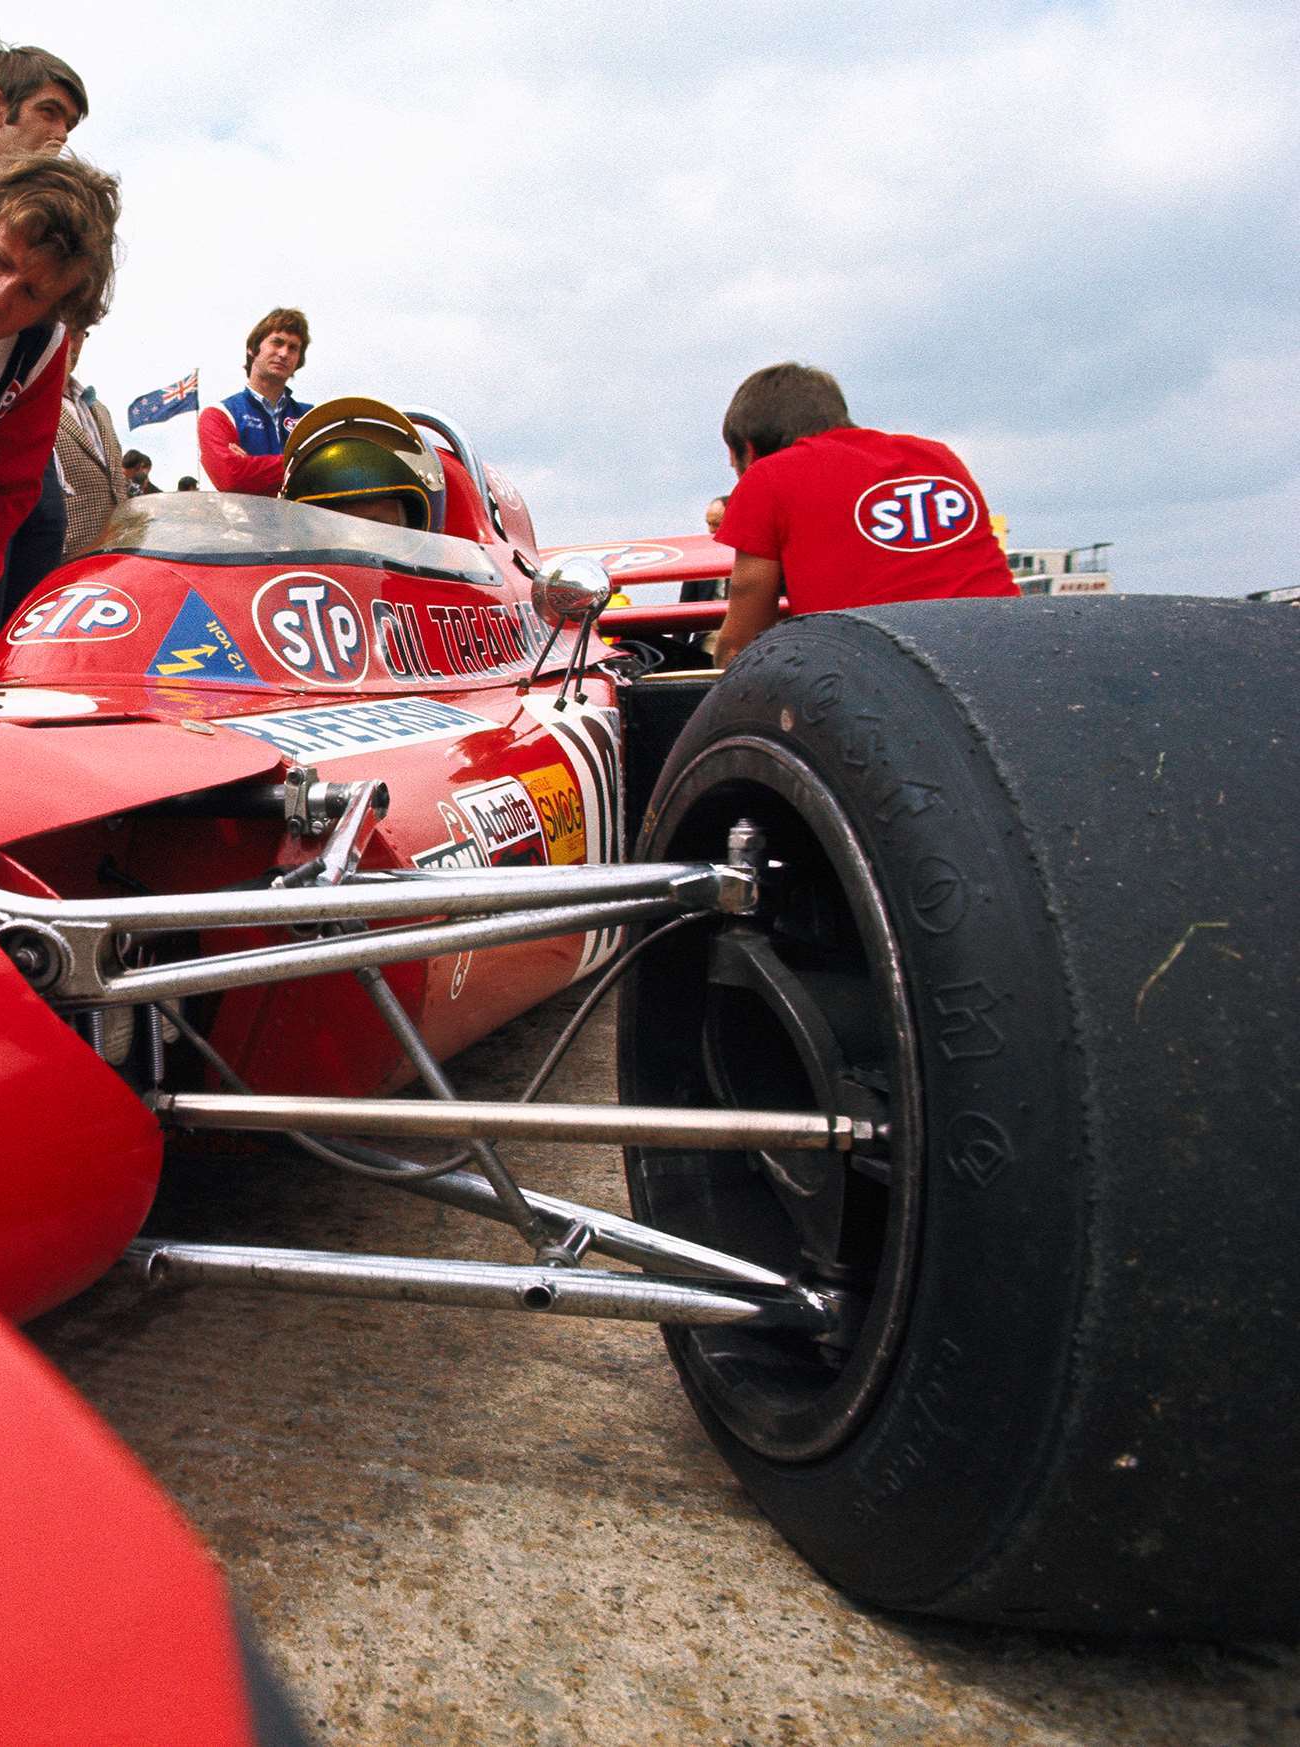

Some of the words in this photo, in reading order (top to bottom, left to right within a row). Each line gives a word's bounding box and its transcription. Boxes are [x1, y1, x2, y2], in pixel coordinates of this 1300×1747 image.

[870, 482, 968, 541] STP
[13, 587, 130, 638] STP
[205, 620, 232, 649] volt
[272, 584, 361, 679] STP
[227, 652, 246, 672] 12
[371, 598, 448, 684] OIL
[470, 793, 537, 848] Autolite
[537, 787, 583, 842] SMOG
